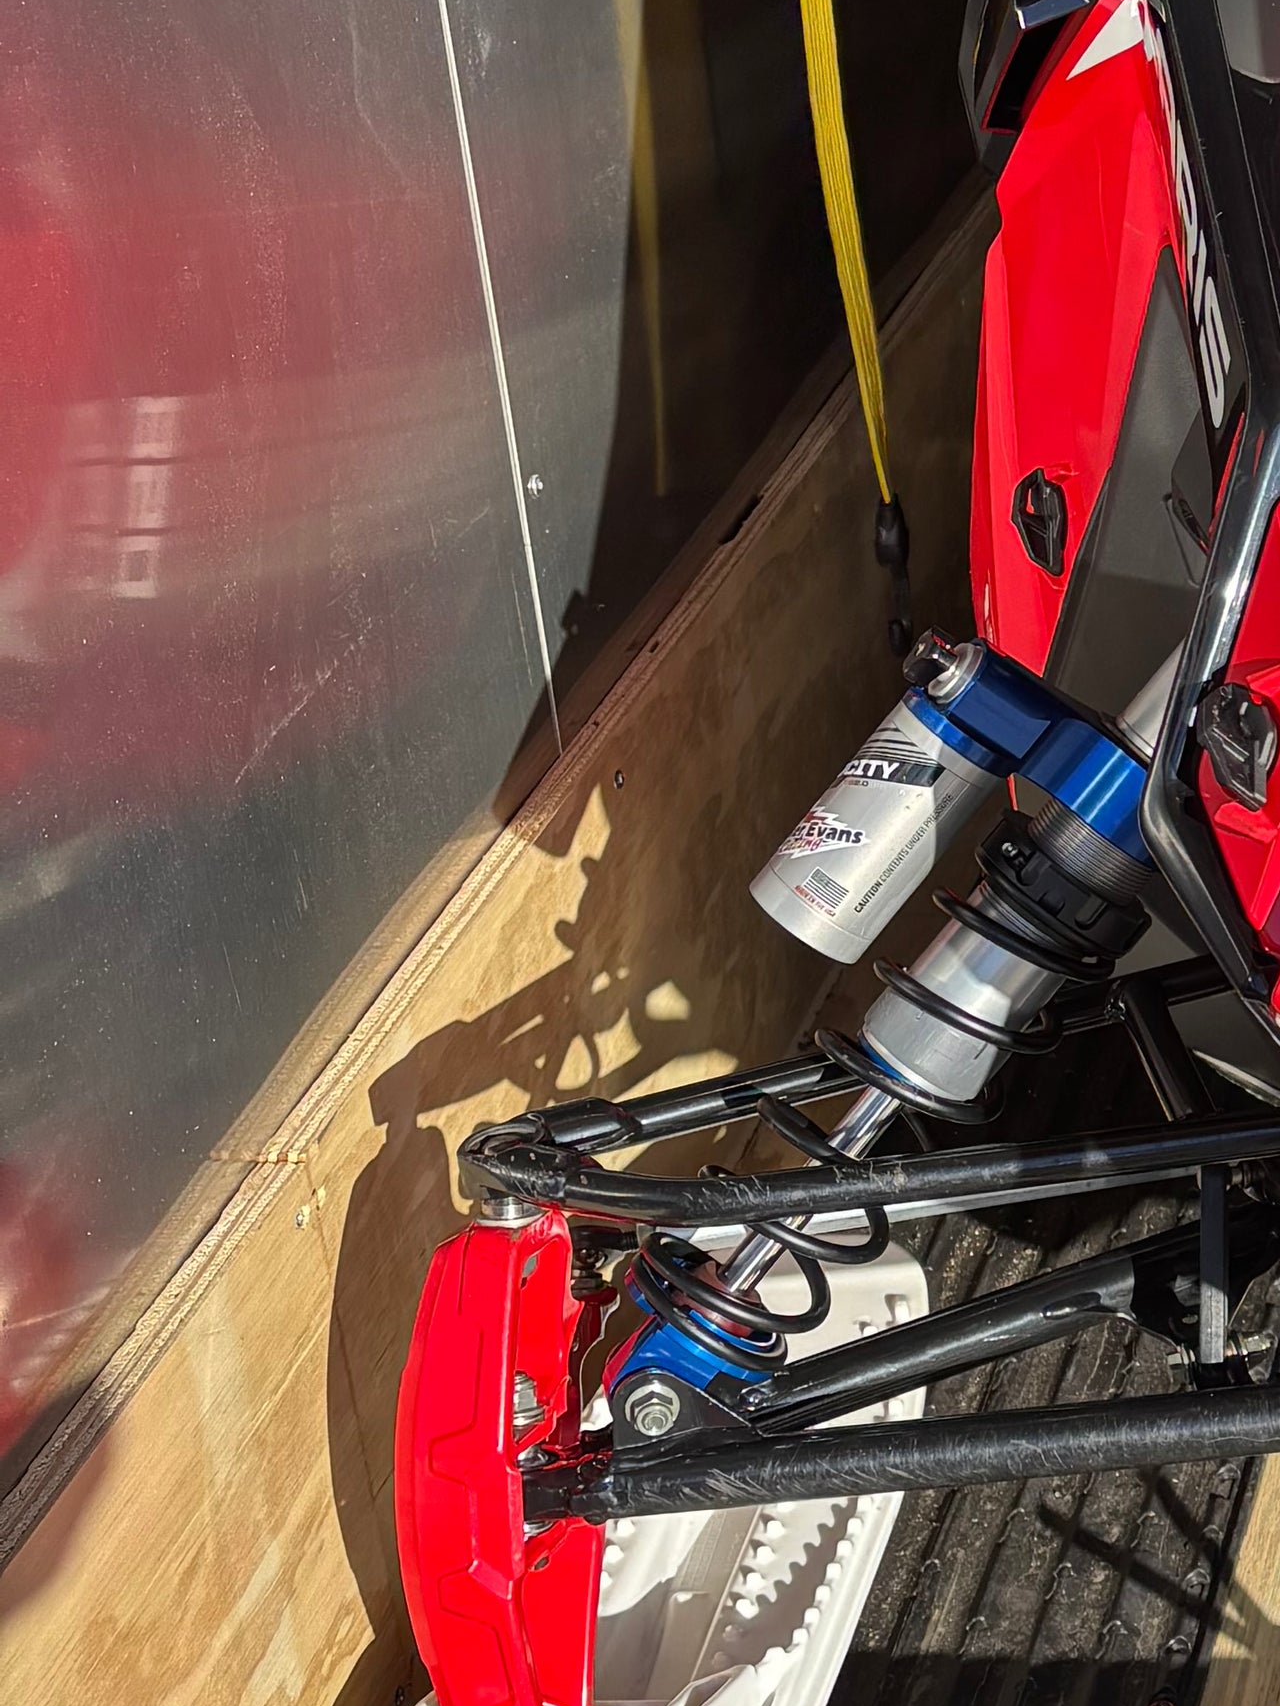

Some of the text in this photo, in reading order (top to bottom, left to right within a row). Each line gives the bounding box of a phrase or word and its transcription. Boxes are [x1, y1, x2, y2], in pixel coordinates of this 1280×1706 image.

[844, 759, 901, 781] CITY
[808, 822, 863, 844] Evans
[854, 793, 954, 913] CAUTION CONTENTS UNDER PRESSURE
